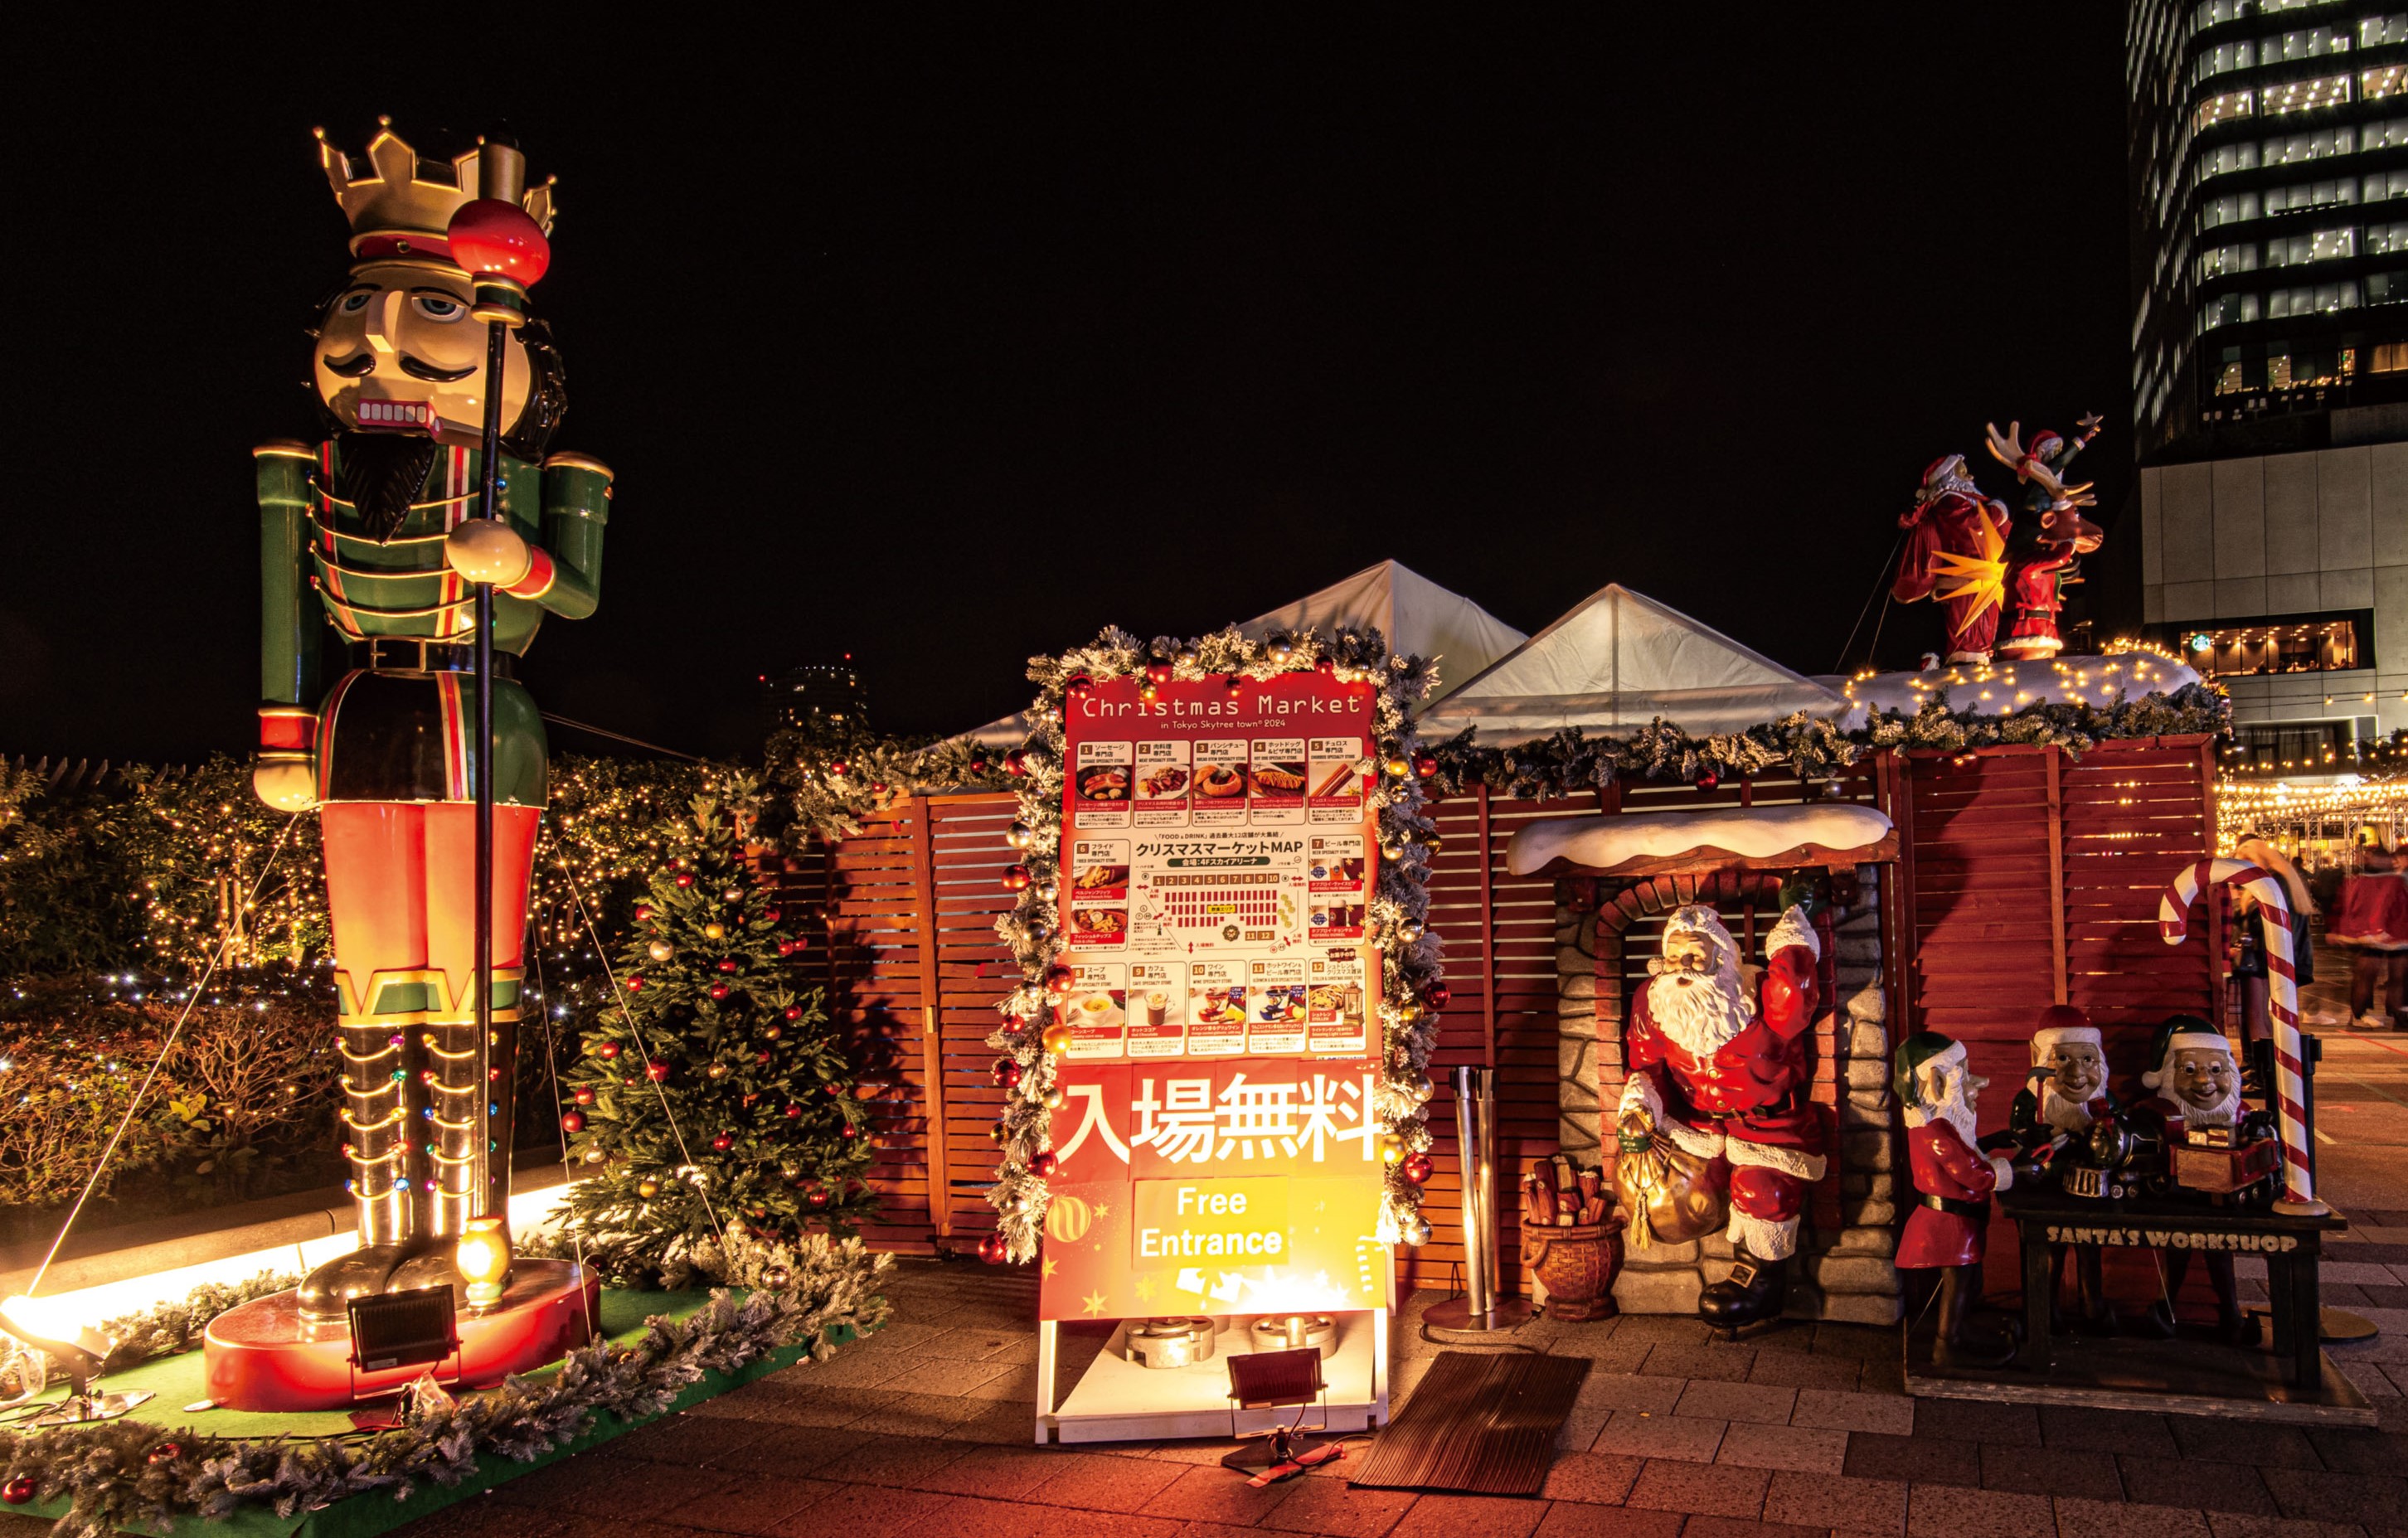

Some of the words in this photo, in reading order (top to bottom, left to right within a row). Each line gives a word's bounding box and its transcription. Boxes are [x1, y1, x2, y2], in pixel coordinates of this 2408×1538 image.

[1082, 697, 1239, 717] Christmas
[1161, 720, 1168, 729] in
[1172, 720, 1197, 730] Tokyo
[1201, 720, 1234, 729] Skytree
[1264, 719, 1285, 727] 2024
[1136, 841, 1303, 856] クリスマスマーケットMAP
[1254, 964, 1263, 973] 11
[1056, 1073, 1383, 1165] 入場無料
[1177, 1187, 1247, 1215] Free
[1141, 1229, 1282, 1257] Entrance
[2046, 1226, 2139, 1245] SANTA'S
[2145, 1230, 2298, 1252] WORKSHOP
